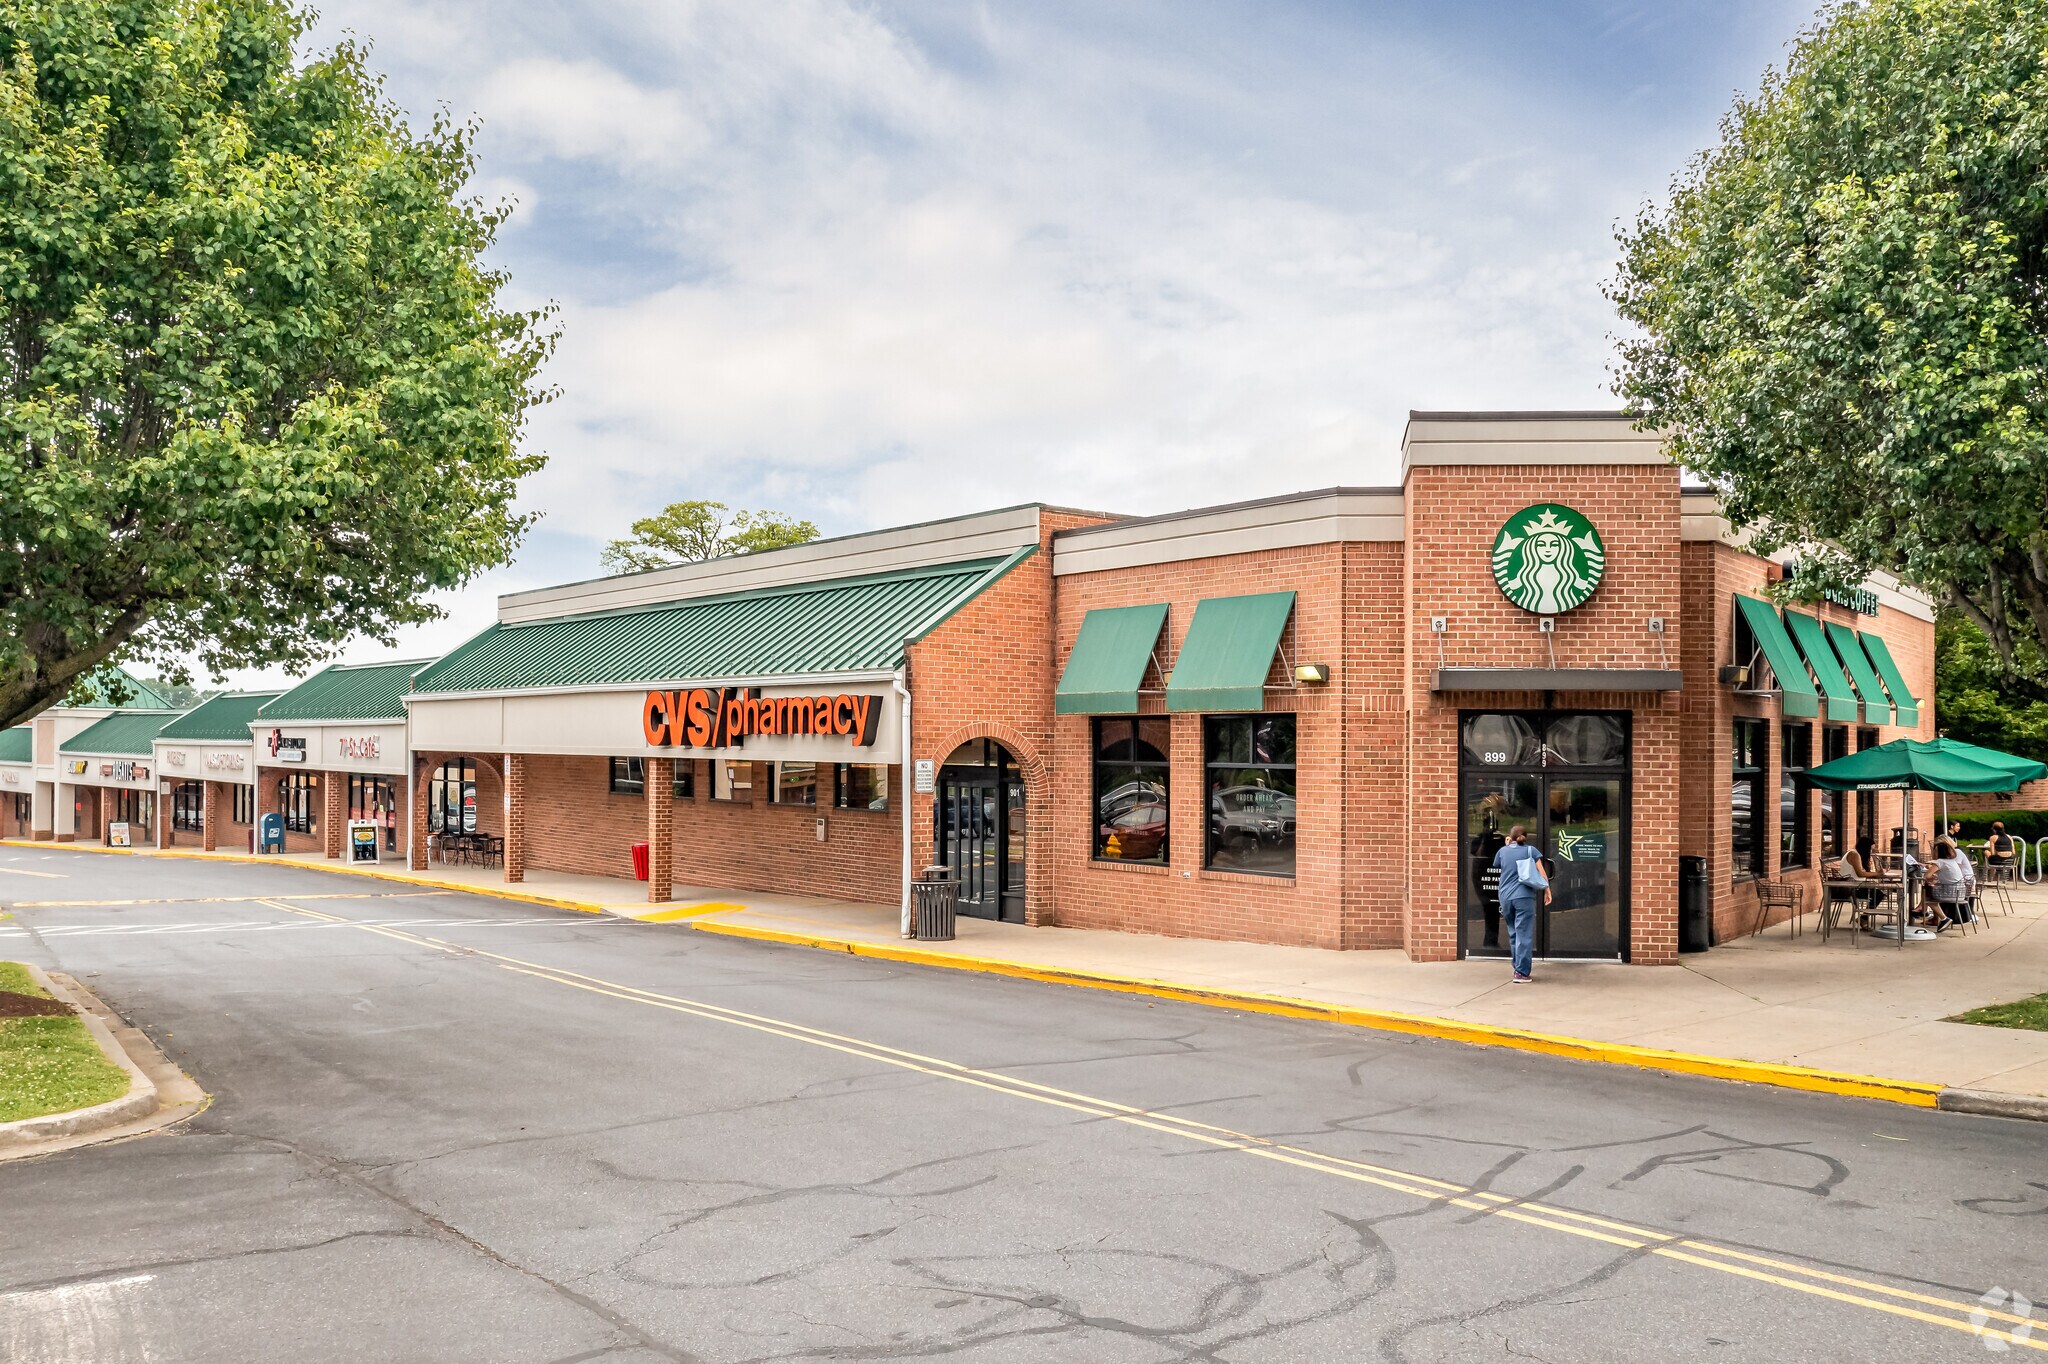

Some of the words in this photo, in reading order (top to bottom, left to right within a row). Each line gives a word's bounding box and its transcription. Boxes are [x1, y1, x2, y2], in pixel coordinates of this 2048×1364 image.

[643, 687, 872, 748] CVS/pharmacy
[1485, 752, 1506, 763] 899
[1010, 788, 1020, 797] 901
[1236, 793, 1254, 802] ORDER
